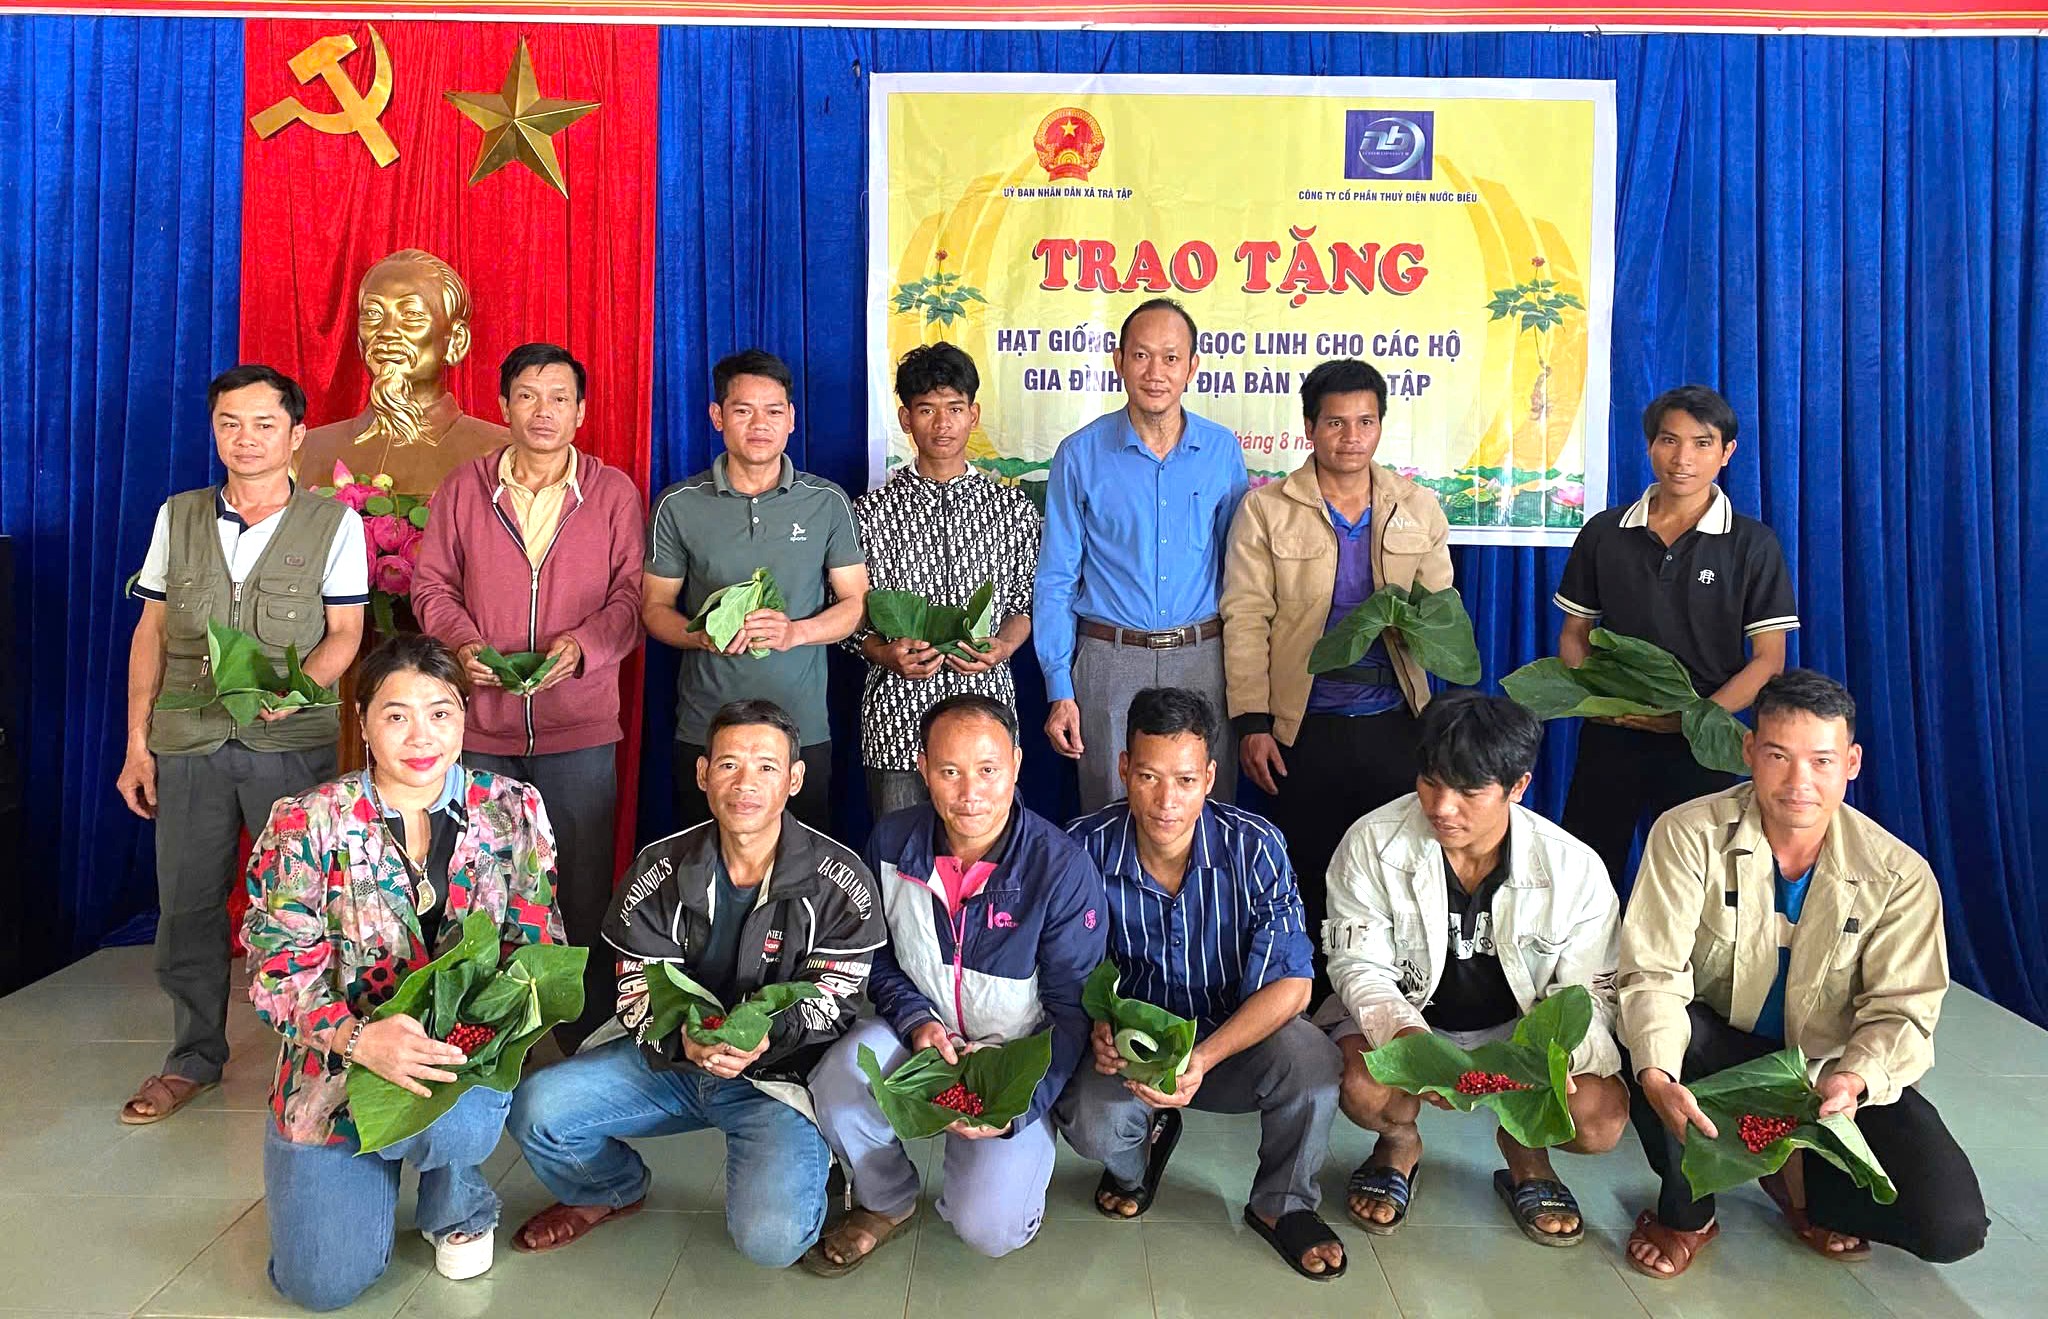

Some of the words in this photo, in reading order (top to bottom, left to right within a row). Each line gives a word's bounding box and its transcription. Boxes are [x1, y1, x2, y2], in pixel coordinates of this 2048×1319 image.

[1018, 188, 1035, 197] BAN
[1038, 186, 1061, 197] NHÂN
[1064, 186, 1081, 197] DÂN
[1084, 187, 1095, 197] XÃ
[1098, 188, 1114, 198] TRÀ
[1116, 187, 1133, 200] TẬP
[1299, 189, 1323, 200] CÔNG
[1326, 191, 1336, 200] TY
[1405, 190, 1427, 204] ĐIỆN
[1429, 190, 1454, 202] NƯỚC
[1032, 238, 1219, 294] TRAO
[1235, 225, 1430, 309] TẶNG
[997, 329, 1041, 356] HẠT
[1048, 322, 1116, 353] GIỐNG
[1199, 331, 1246, 359] GỌC
[1254, 332, 1307, 355] LINH
[1316, 333, 1364, 356] CHO
[1372, 329, 1419, 357] CÁC
[1428, 330, 1461, 362] HỘ
[1024, 368, 1062, 391] GIA
[1069, 364, 1122, 392] ĐÌNH
[1197, 371, 1236, 399] ĐỊA
[1244, 366, 1291, 394] BÀN
[1387, 369, 1431, 401] TẬP
[1279, 431, 1290, 449] 8
